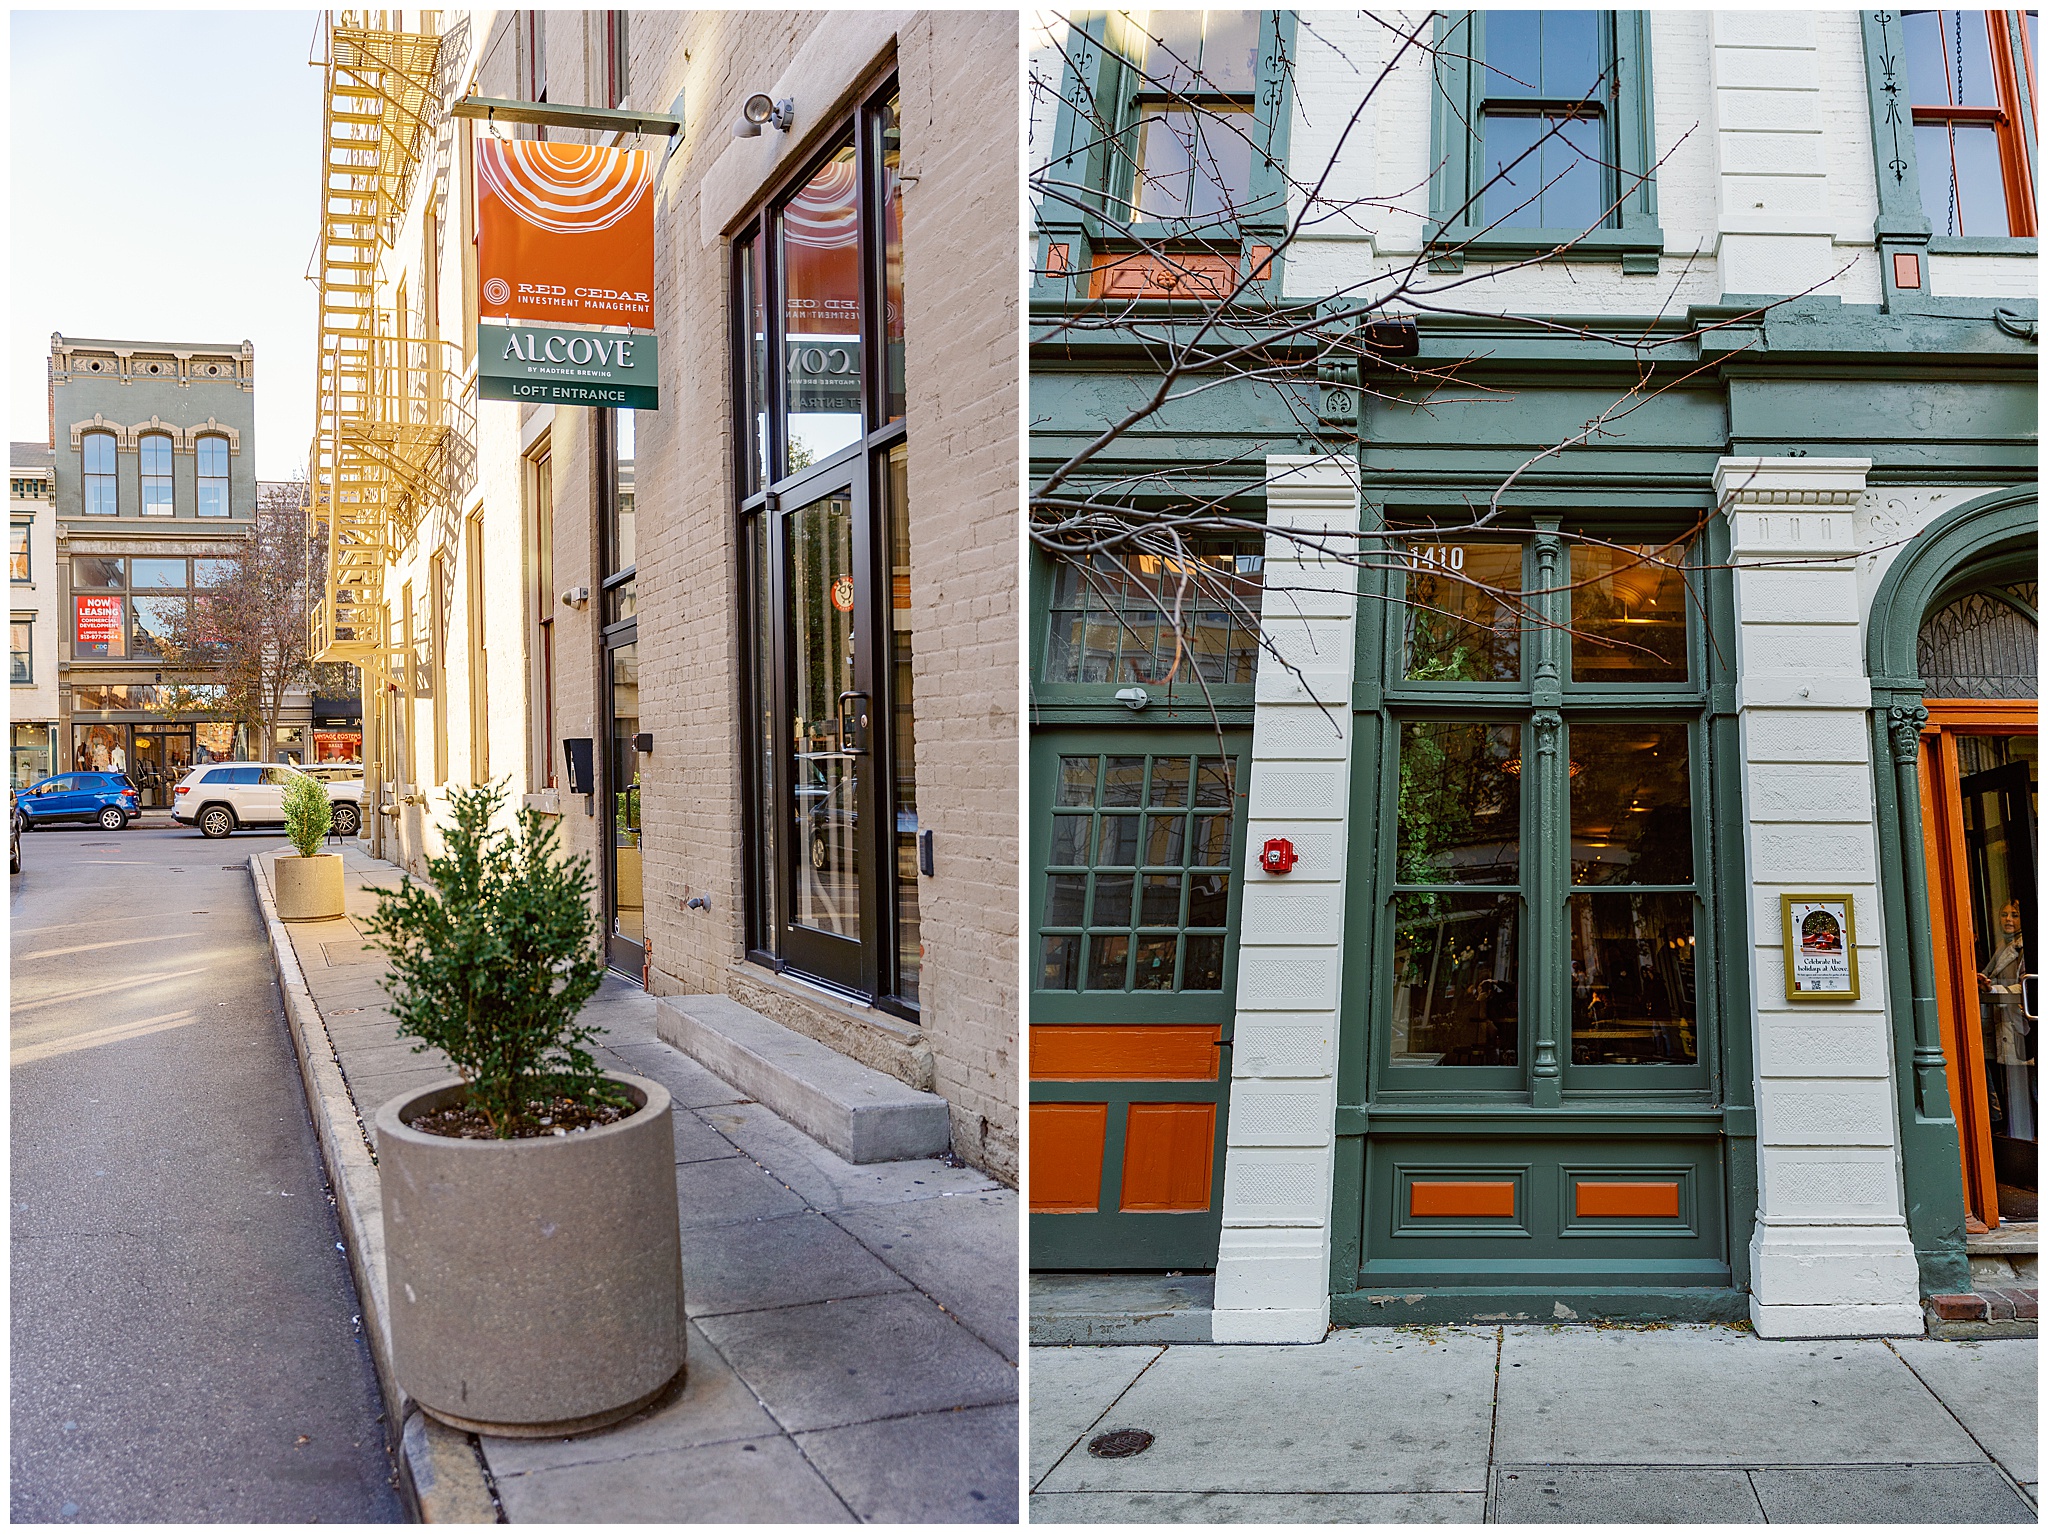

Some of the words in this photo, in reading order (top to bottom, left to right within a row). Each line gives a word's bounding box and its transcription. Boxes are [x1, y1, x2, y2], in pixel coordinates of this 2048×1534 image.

[518, 283, 567, 296] RED
[574, 287, 650, 302] CEDAR
[518, 295, 579, 307] INVESTMENT
[585, 300, 650, 313] MANAGEMENT
[503, 332, 634, 368] ALCOVE
[540, 367, 575, 376] MADTREE
[577, 369, 612, 378] BREWING
[513, 384, 547, 397] LOFT
[552, 388, 626, 402] ENTRANCE
[1410, 546, 1464, 570] 1410
[88, 599, 110, 607] NOW
